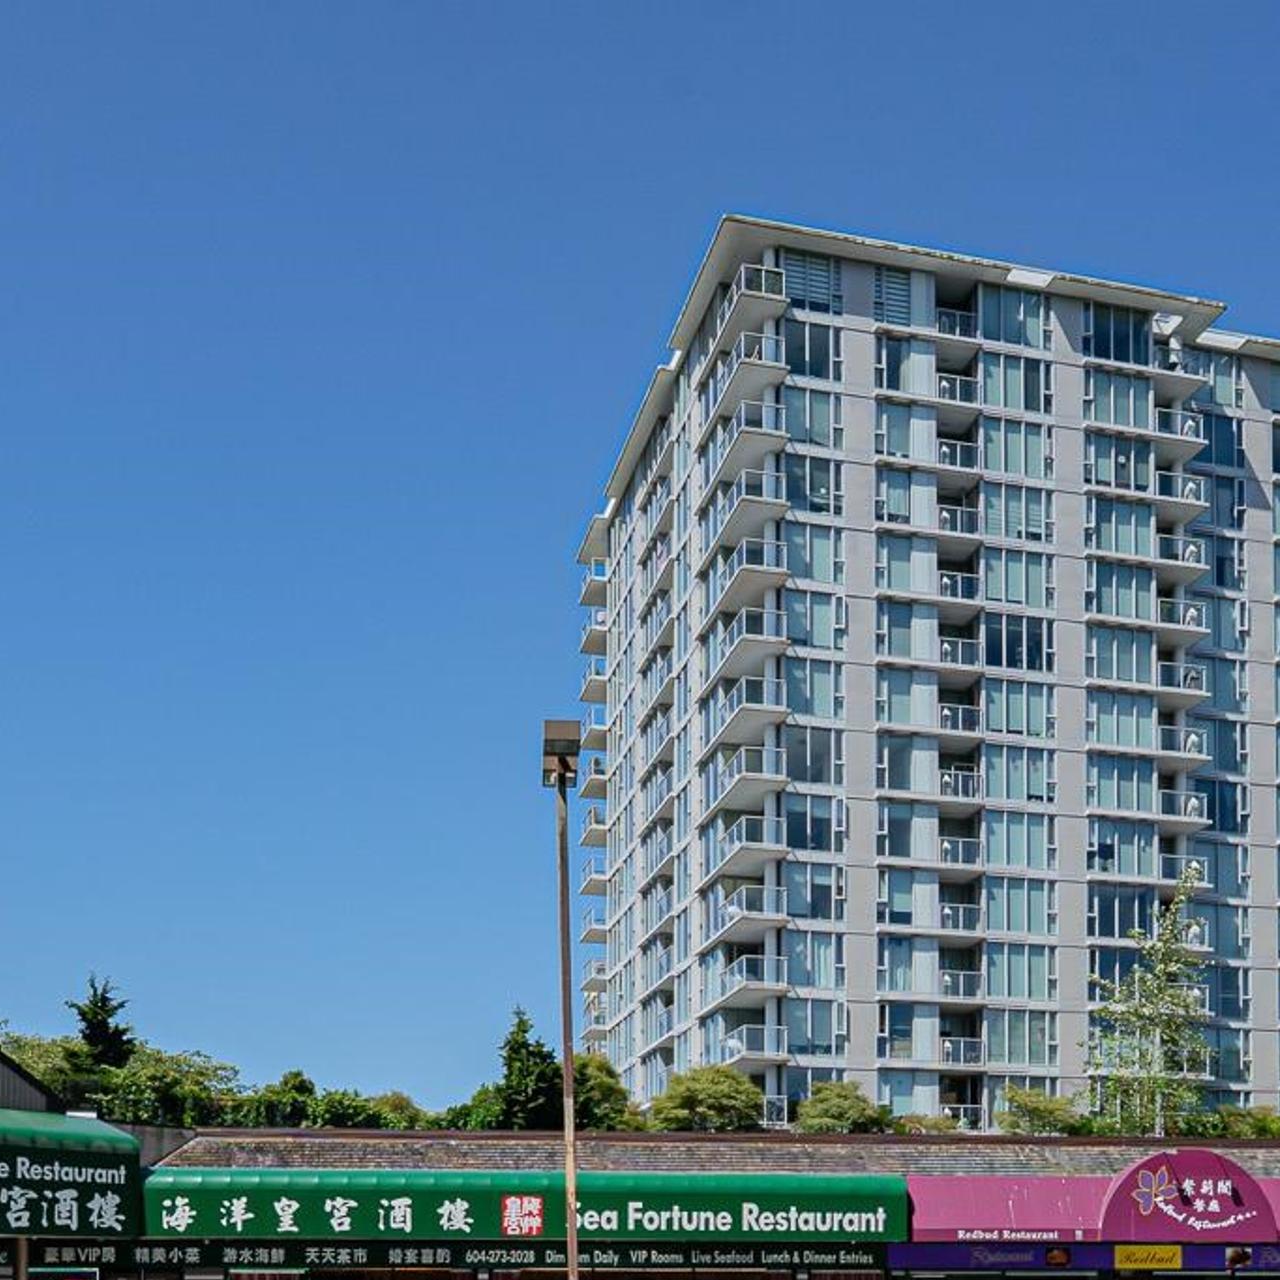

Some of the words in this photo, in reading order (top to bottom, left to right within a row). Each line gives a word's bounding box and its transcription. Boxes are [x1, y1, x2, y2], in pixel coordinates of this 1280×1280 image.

[16, 1156, 126, 1185] Restaurant
[161, 1196, 475, 1234] 海洋皇宮酒樓
[627, 1201, 733, 1232] Fortune
[741, 1202, 887, 1233] Restaurant
[956, 1230, 1000, 1241] Redbud
[1002, 1230, 1060, 1241] Restaurant
[465, 1250, 535, 1264] 604-273-2028
[546, 1250, 566, 1264] Dim
[593, 1250, 620, 1267] Daily
[630, 1250, 648, 1264] VIP
[651, 1250, 684, 1264] Rooms
[691, 1250, 712, 1264] Live
[714, 1250, 755, 1264] Seafood
[761, 1250, 790, 1264] Lunch
[803, 1250, 837, 1264] Dinner
[1120, 1251, 1176, 1265] Redbud
